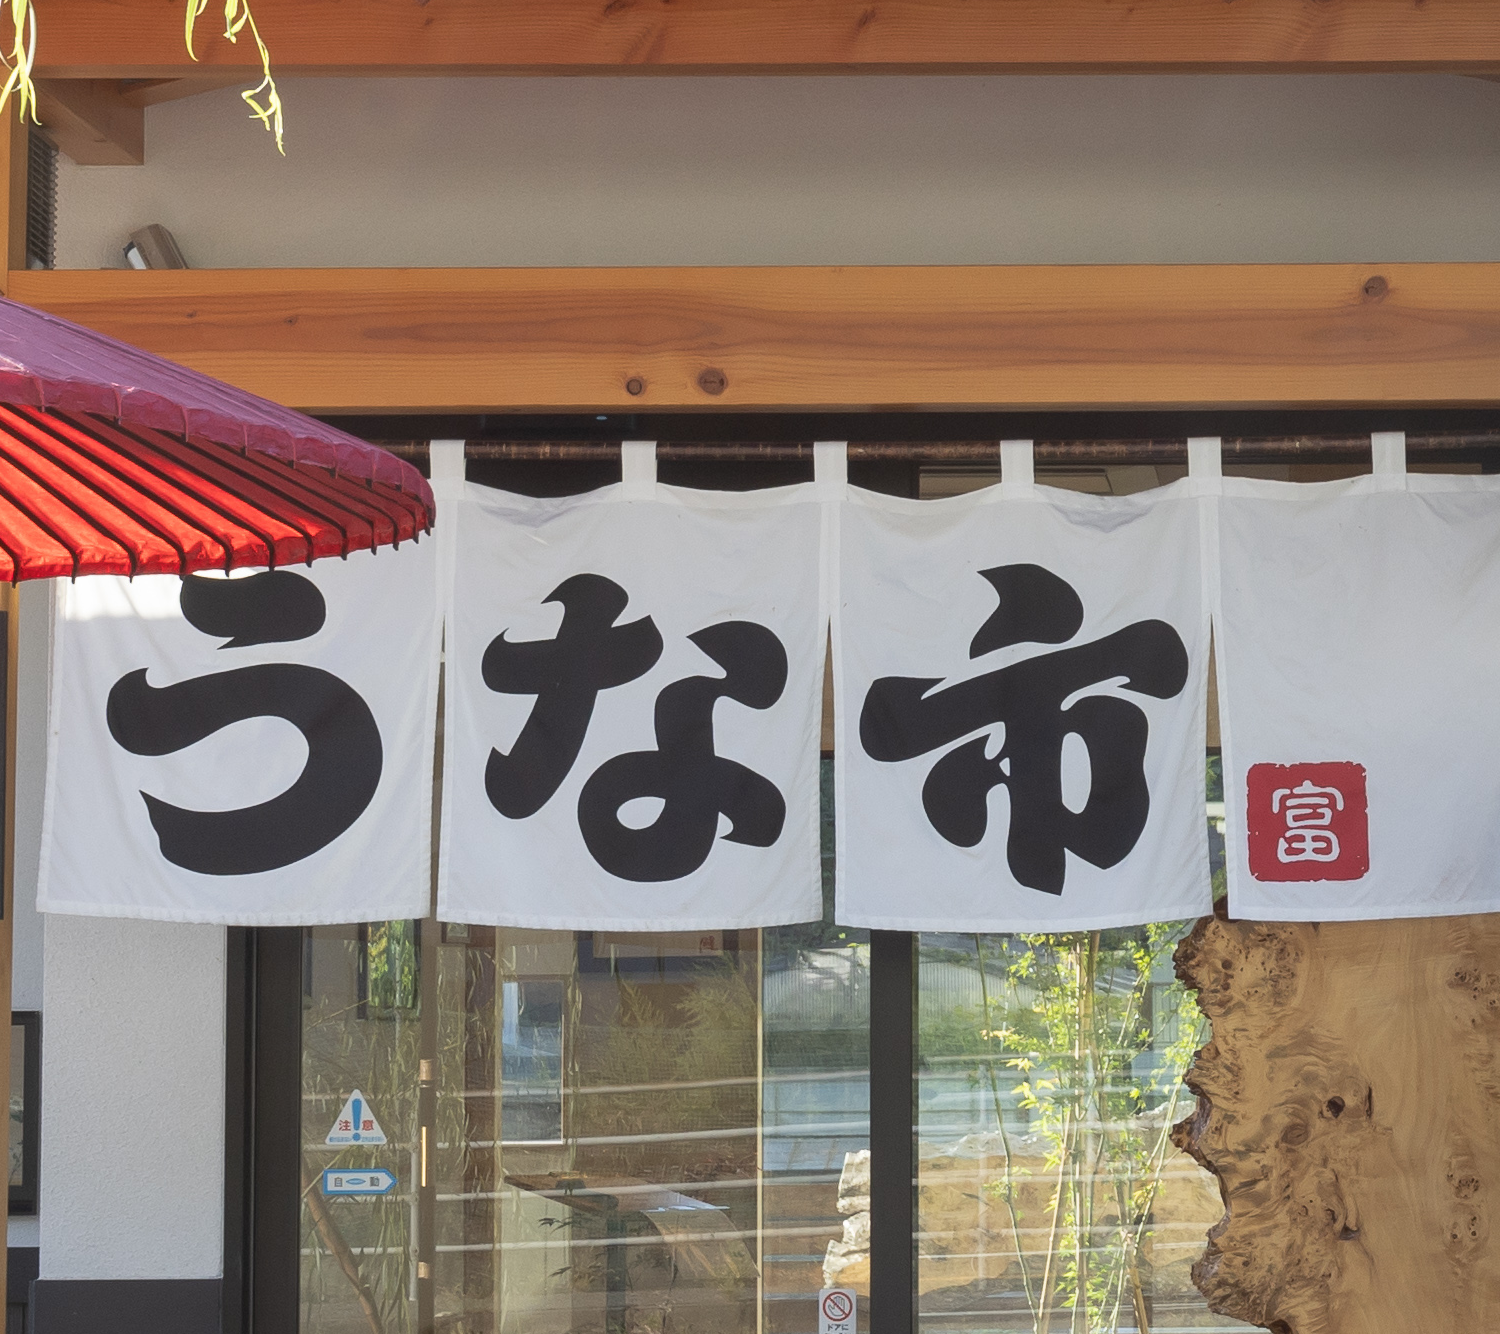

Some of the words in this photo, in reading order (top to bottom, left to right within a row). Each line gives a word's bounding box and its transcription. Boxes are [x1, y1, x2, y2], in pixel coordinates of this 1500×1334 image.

[106, 563, 1190, 897] うな市
[1270, 779, 1345, 864] 富
[827, 1323, 850, 1332] ドアに
